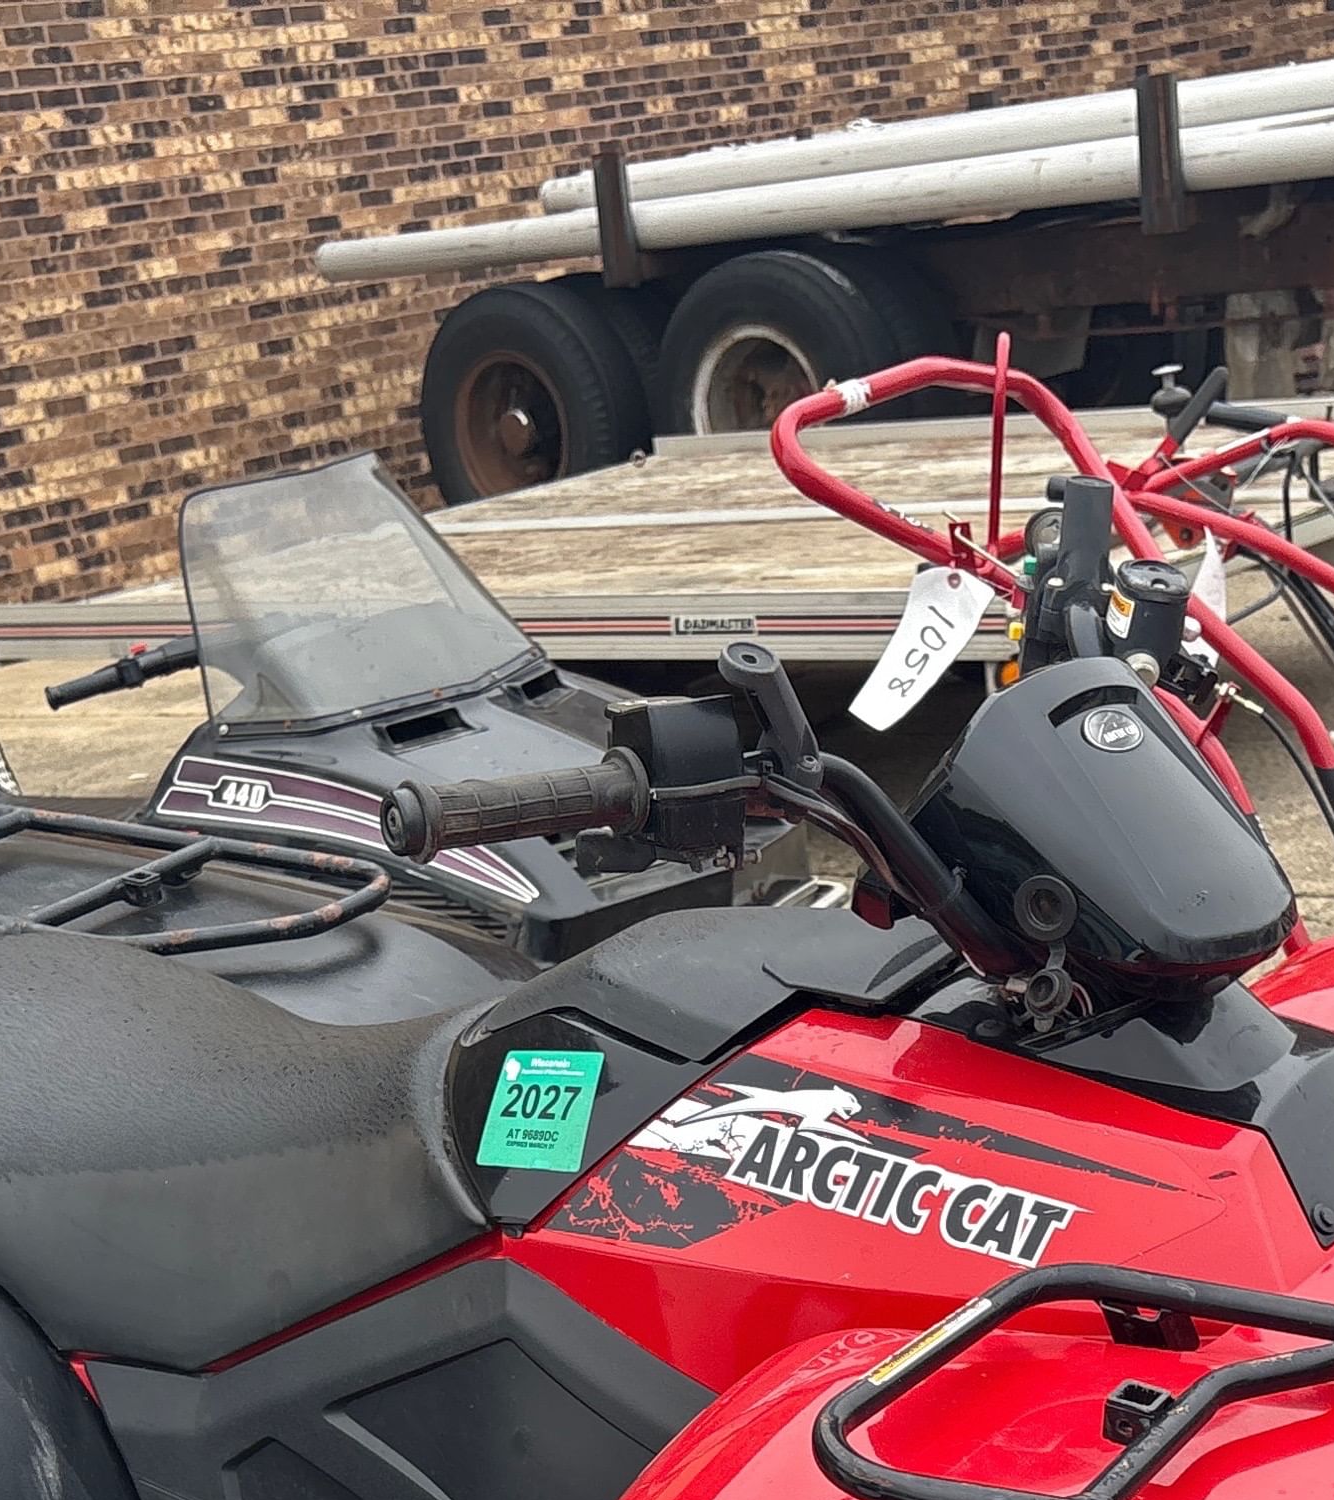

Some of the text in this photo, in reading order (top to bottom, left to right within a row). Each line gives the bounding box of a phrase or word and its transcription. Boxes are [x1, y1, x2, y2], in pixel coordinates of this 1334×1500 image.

[887, 605, 955, 698] 1058
[221, 781, 266, 808] 440
[500, 1083, 583, 1120] 2027
[506, 1128, 522, 1139] AT
[728, 1122, 1074, 1266] ARCTIC CAT
